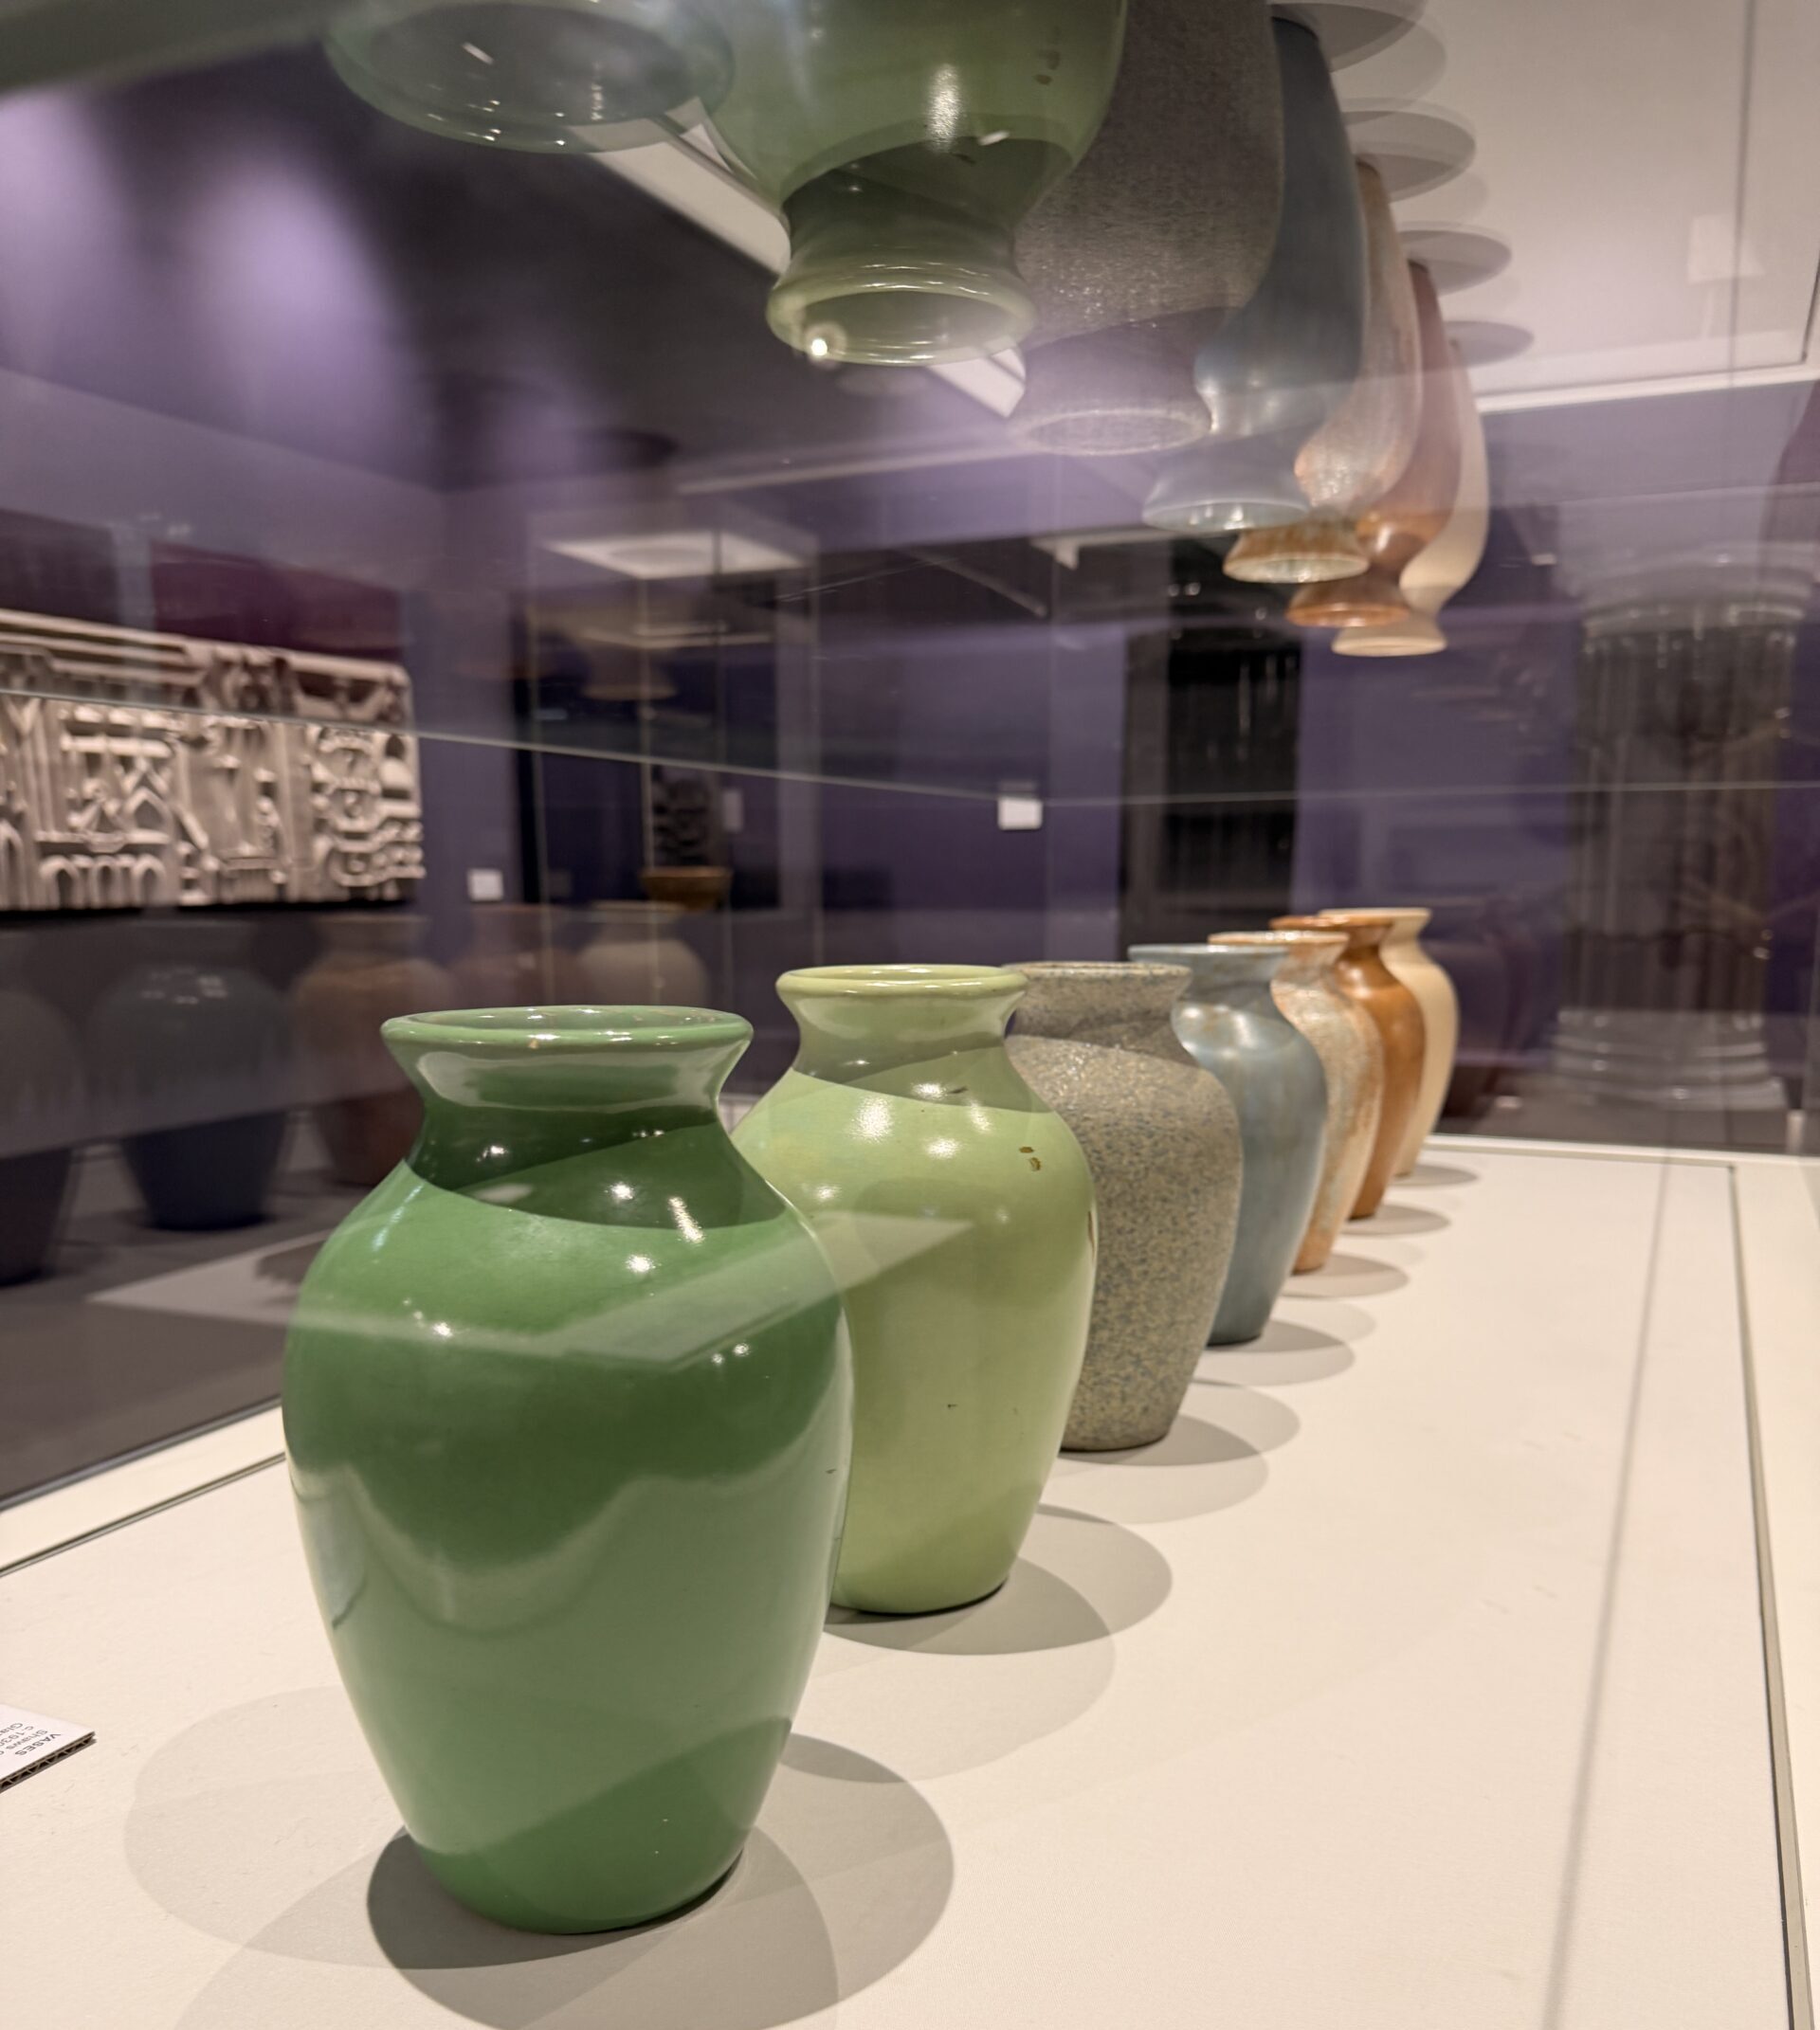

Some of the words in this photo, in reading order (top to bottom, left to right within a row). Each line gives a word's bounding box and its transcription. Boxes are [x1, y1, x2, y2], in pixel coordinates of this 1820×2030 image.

[0, 1723, 23, 1736] Gla
[6, 1730, 47, 1749] Shaws
[15, 1733, 61, 1755] VASES
